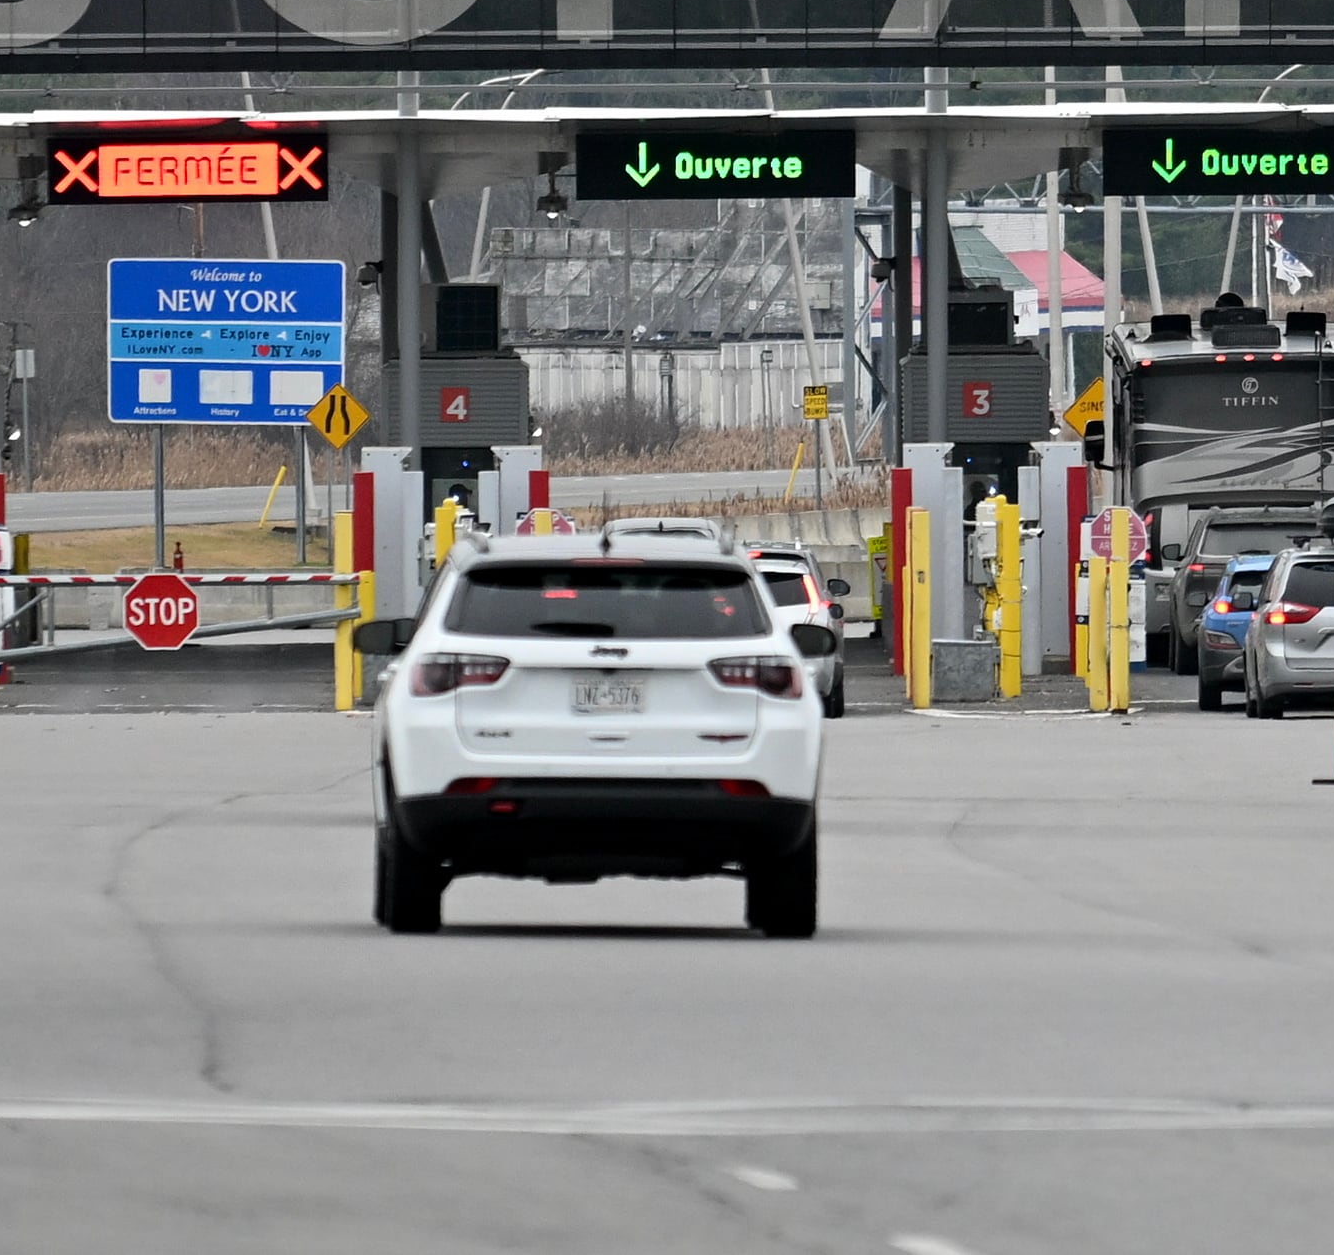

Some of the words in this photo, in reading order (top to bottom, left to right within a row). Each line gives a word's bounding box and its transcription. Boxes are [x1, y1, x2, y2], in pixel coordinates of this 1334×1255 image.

[114, 148, 258, 186] FERMÉE
[675, 151, 803, 181] Ouverte
[1201, 148, 1330, 178] Ouverte
[190, 267, 244, 282] Welcome
[248, 270, 263, 282] to
[157, 289, 216, 313] NEW
[223, 290, 298, 314] YORK
[121, 327, 194, 341] Experience
[220, 328, 270, 341] Explore
[295, 330, 331, 344] Enjoy
[300, 347, 322, 358] App
[133, 406, 177, 416] Attractions
[211, 407, 240, 418] History
[445, 393, 468, 420] 4
[971, 390, 990, 415] 3
[1222, 396, 1279, 407] TIFFIN
[128, 596, 196, 626] STOP
